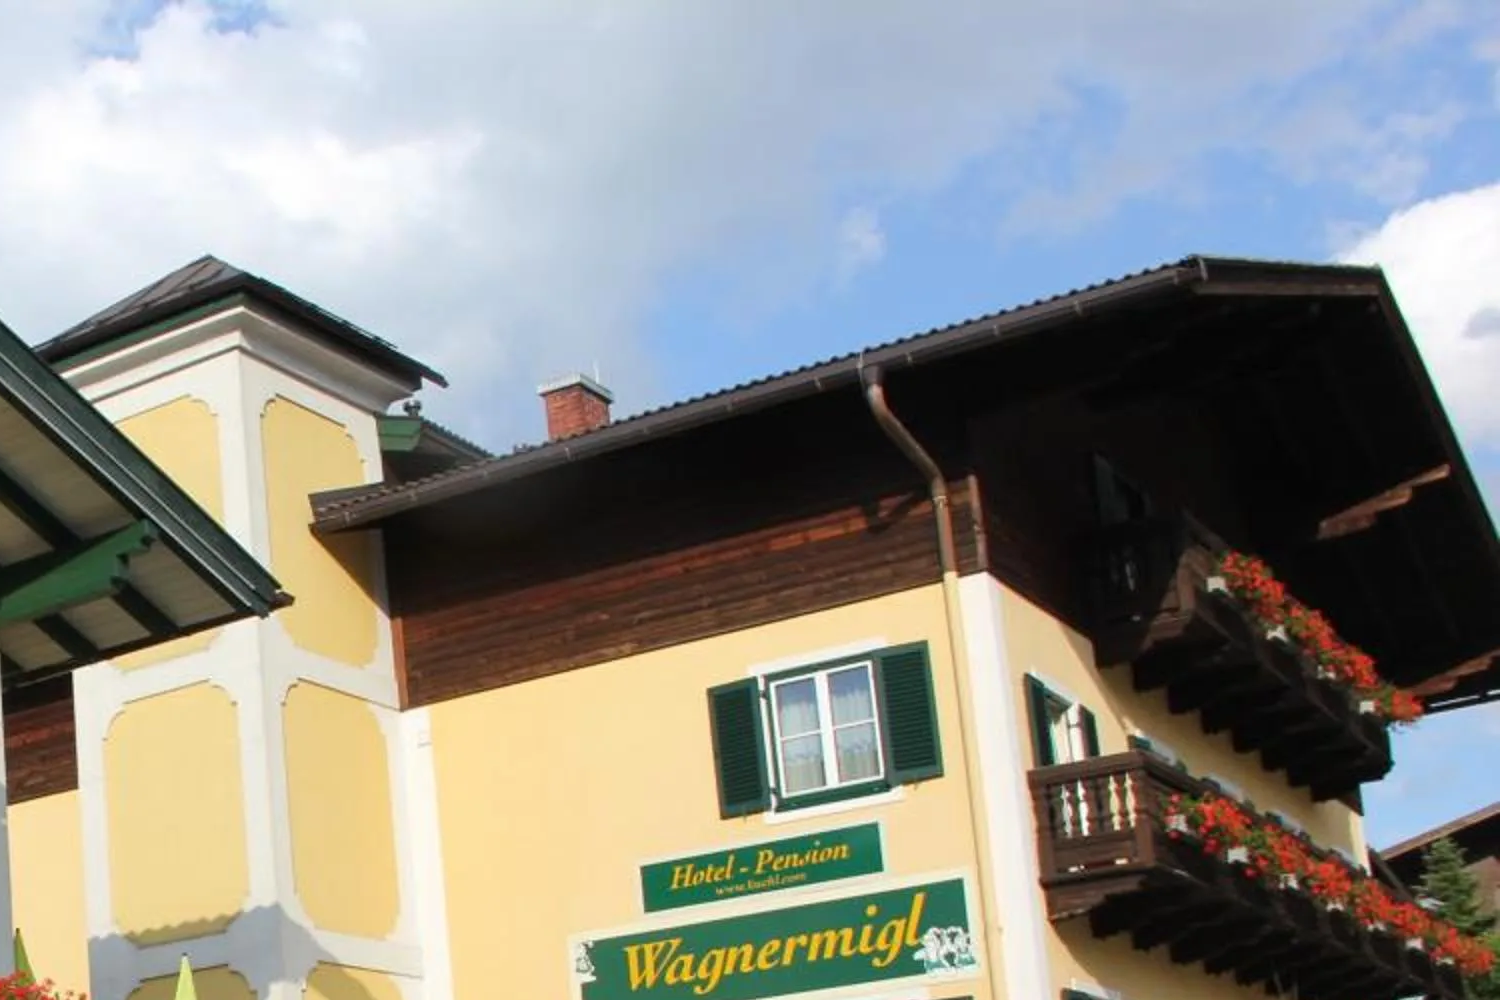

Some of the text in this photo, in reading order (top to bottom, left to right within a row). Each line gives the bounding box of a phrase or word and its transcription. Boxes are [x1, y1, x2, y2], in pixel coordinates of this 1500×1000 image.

[671, 853, 736, 890] Hotel
[755, 840, 850, 876] Pension
[623, 891, 927, 995] Wagnermigl
